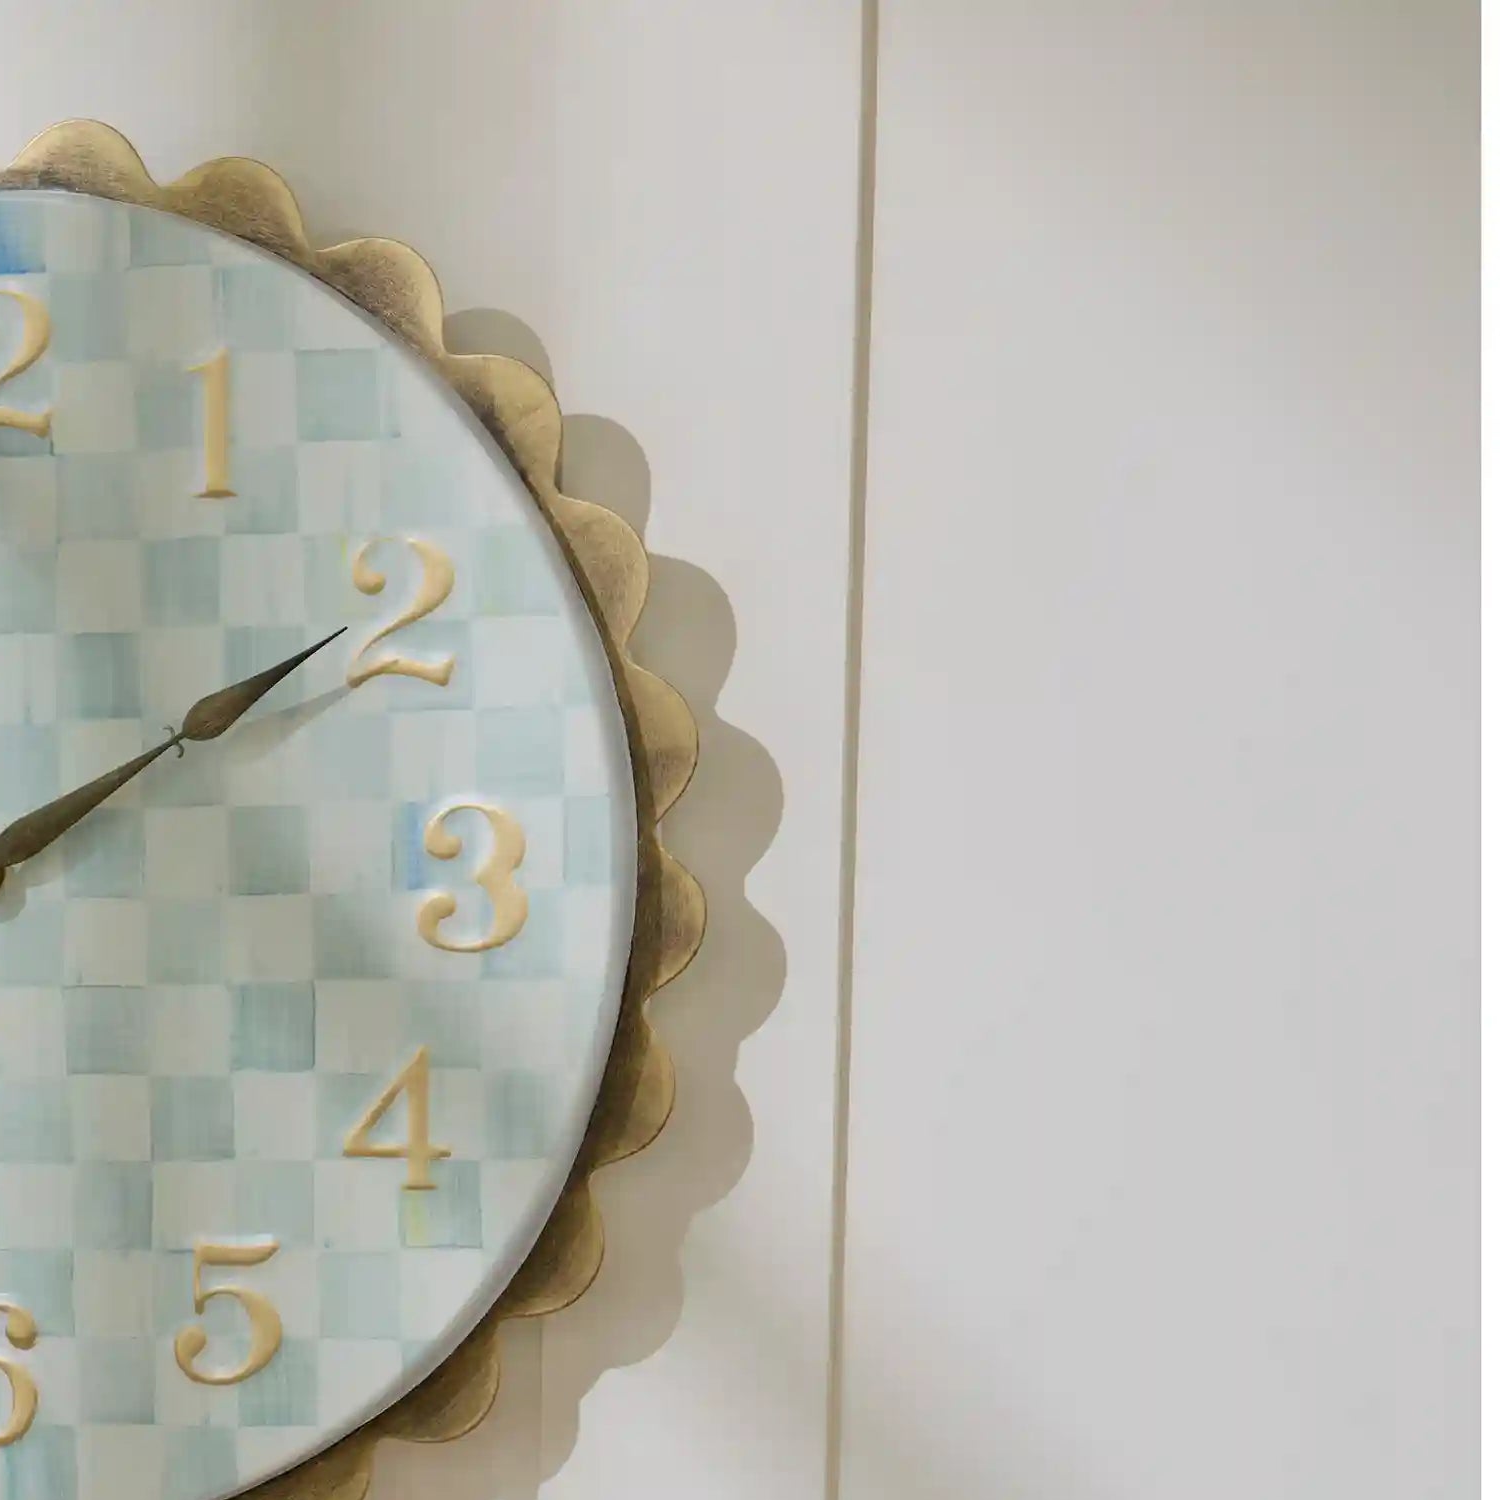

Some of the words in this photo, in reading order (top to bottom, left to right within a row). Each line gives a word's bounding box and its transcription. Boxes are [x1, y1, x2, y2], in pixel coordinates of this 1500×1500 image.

[183, 350, 238, 499] 1
[349, 537, 454, 688] 2
[418, 804, 527, 952] 3
[344, 1047, 451, 1192] 4
[174, 1241, 282, 1386] 5
